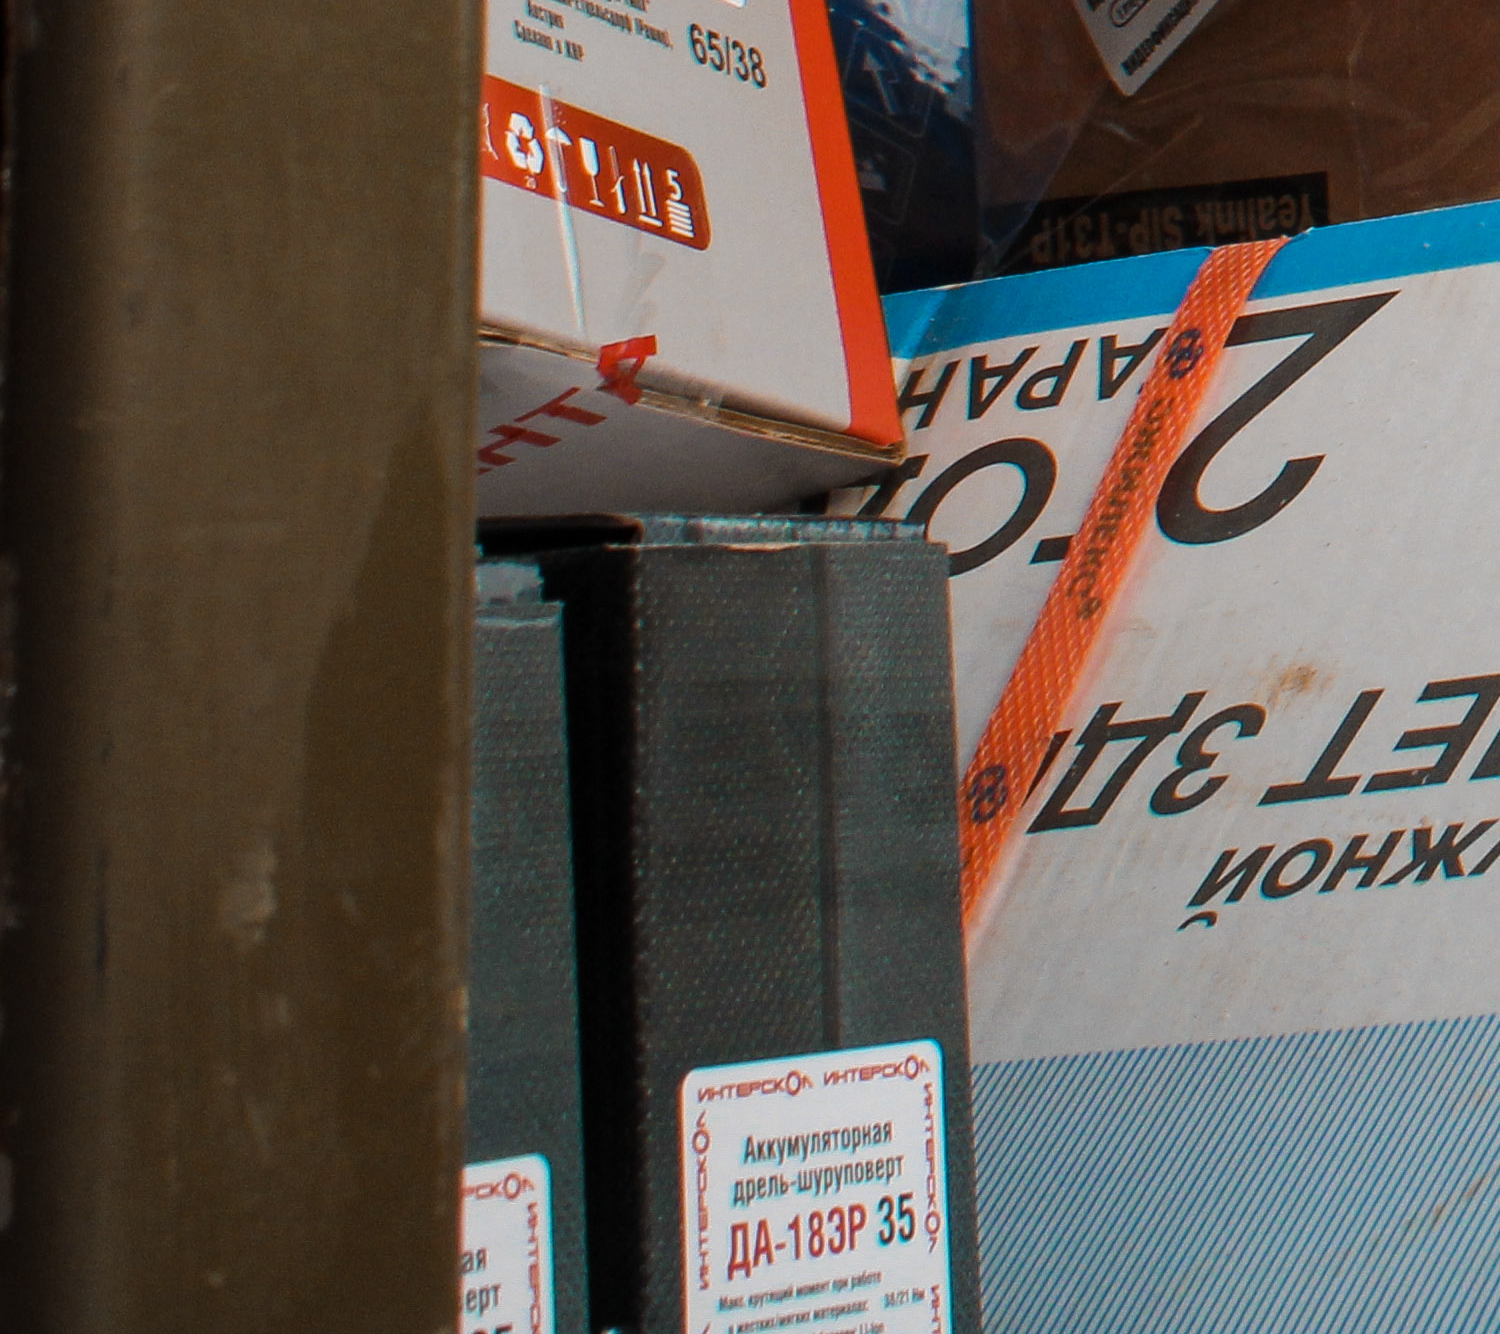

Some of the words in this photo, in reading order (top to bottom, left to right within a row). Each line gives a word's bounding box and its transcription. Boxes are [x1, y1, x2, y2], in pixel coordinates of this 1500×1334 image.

[689, 23, 768, 89] 65/38
[698, 1070, 813, 1103] ИНТЕРСКОЛ
[824, 1054, 930, 1087] ИНТЕРСКОЛ
[743, 1121, 893, 1165] Аккумуляторная
[731, 1154, 905, 1207] дрель-шуруповерт
[728, 1203, 868, 1281] ДА-18ЭР
[877, 1192, 917, 1246] 35
